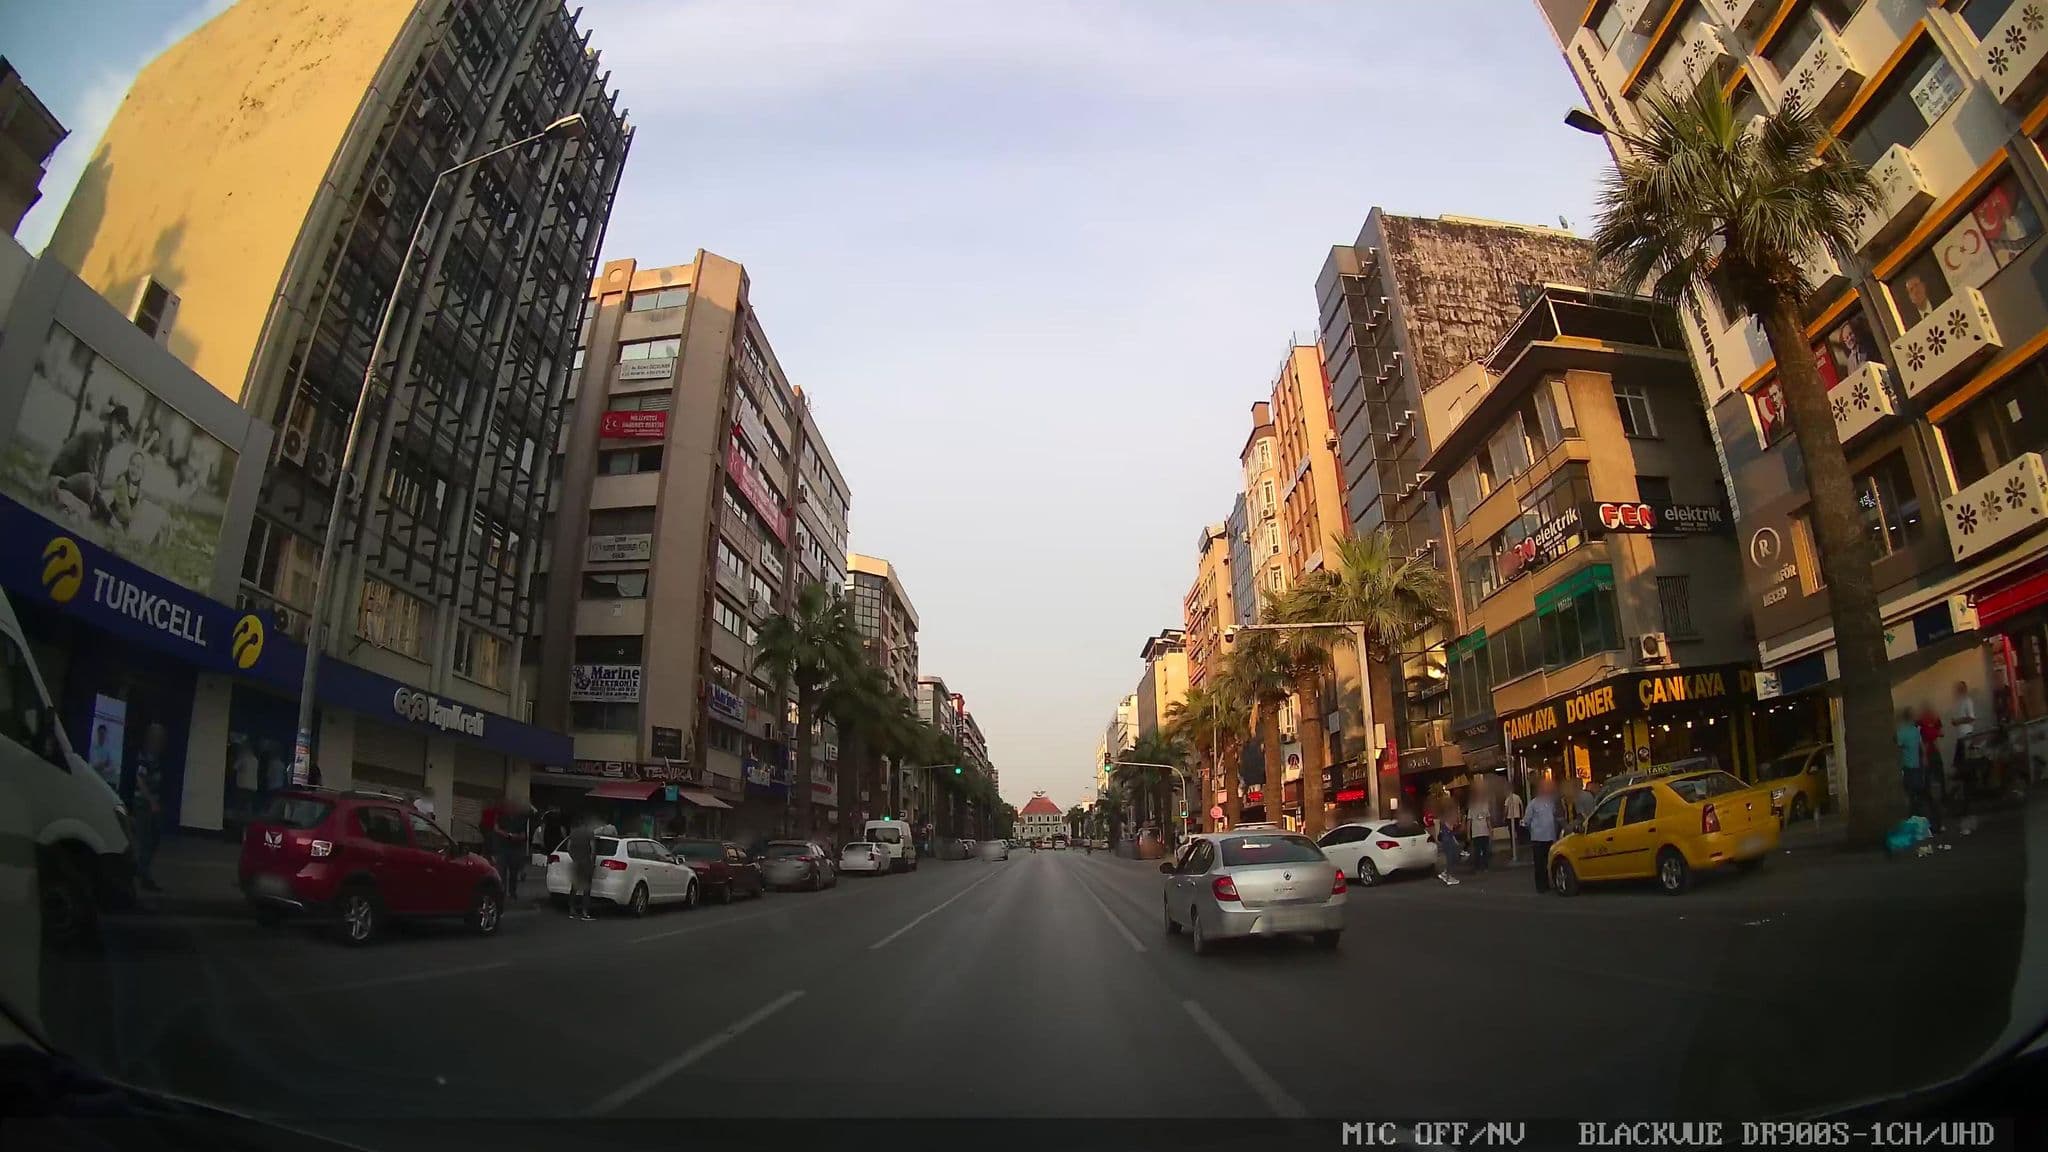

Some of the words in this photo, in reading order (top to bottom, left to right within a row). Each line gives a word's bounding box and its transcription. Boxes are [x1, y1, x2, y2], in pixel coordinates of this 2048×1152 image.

[1535, 507, 1579, 546] elektrik
[1599, 503, 1657, 530] FEN
[1665, 507, 1722, 522] elektrik
[93, 568, 208, 647] TURKCELL
[591, 666, 640, 680] Marine
[1638, 671, 1726, 711] ÇANKAYA
[1565, 685, 1617, 725] DÖNER
